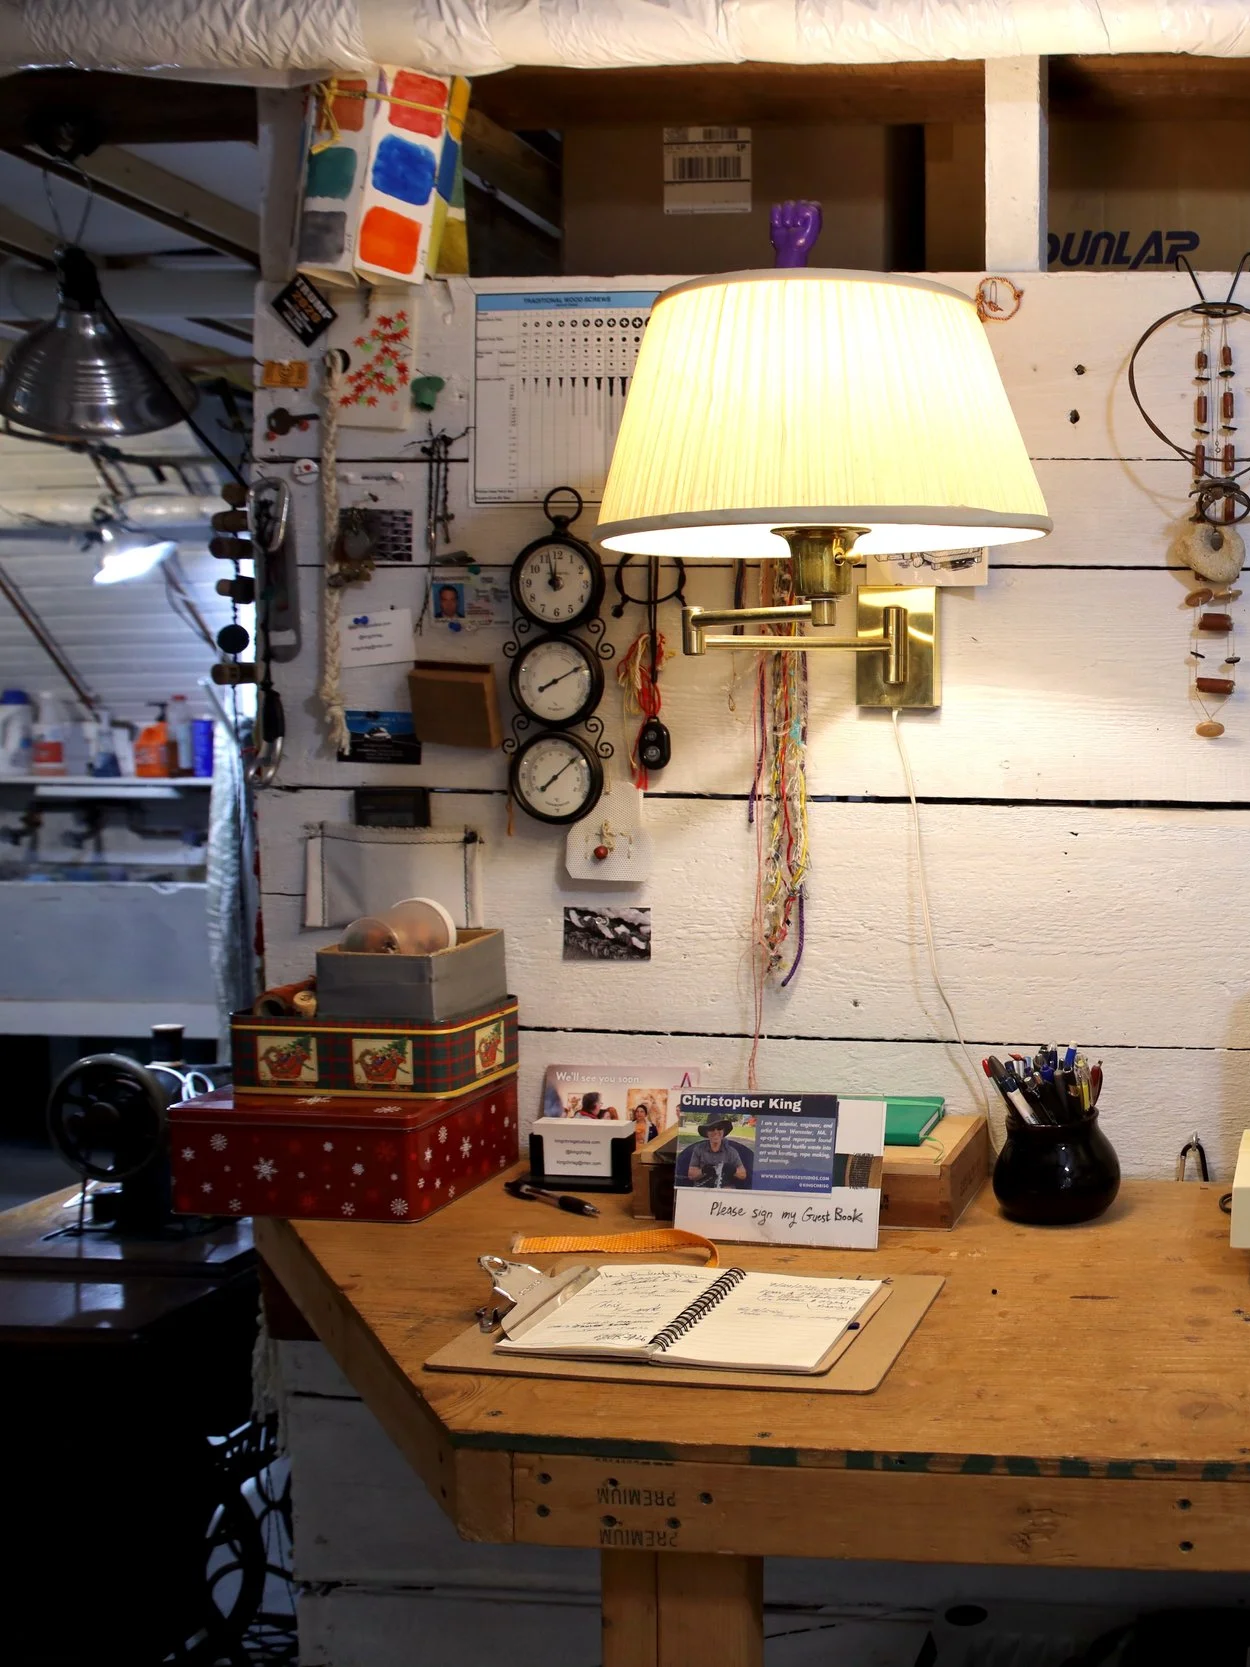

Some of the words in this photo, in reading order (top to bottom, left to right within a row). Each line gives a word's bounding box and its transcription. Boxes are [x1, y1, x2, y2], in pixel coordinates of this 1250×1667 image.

[295, 277, 333, 319] TRUMP
[523, 297, 563, 305] TRADITIONAL
[552, 551, 563, 560] 12
[569, 555, 574, 564] 1
[530, 565, 540, 574] 10
[578, 566, 584, 575] 2
[526, 579, 532, 588] 9
[582, 580, 589, 589] 3
[529, 593, 536, 602] 8
[578, 595, 584, 603] 4
[540, 604, 546, 613] 7
[554, 608, 560, 617] 6
[568, 604, 574, 613] 5
[556, 1071, 579, 1082] We'll
[581, 1074, 596, 1083] see
[599, 1075, 616, 1085] you
[618, 1075, 642, 1083] soon.
[682, 1094, 763, 1110] Christopher
[768, 1098, 802, 1112] King
[709, 1201, 746, 1217] Please
[752, 1206, 773, 1226] sign
[781, 1210, 798, 1228] my
[801, 1206, 831, 1222] Guest
[834, 1206, 864, 1223] Book
[597, 1487, 677, 1507] PREMIUM
